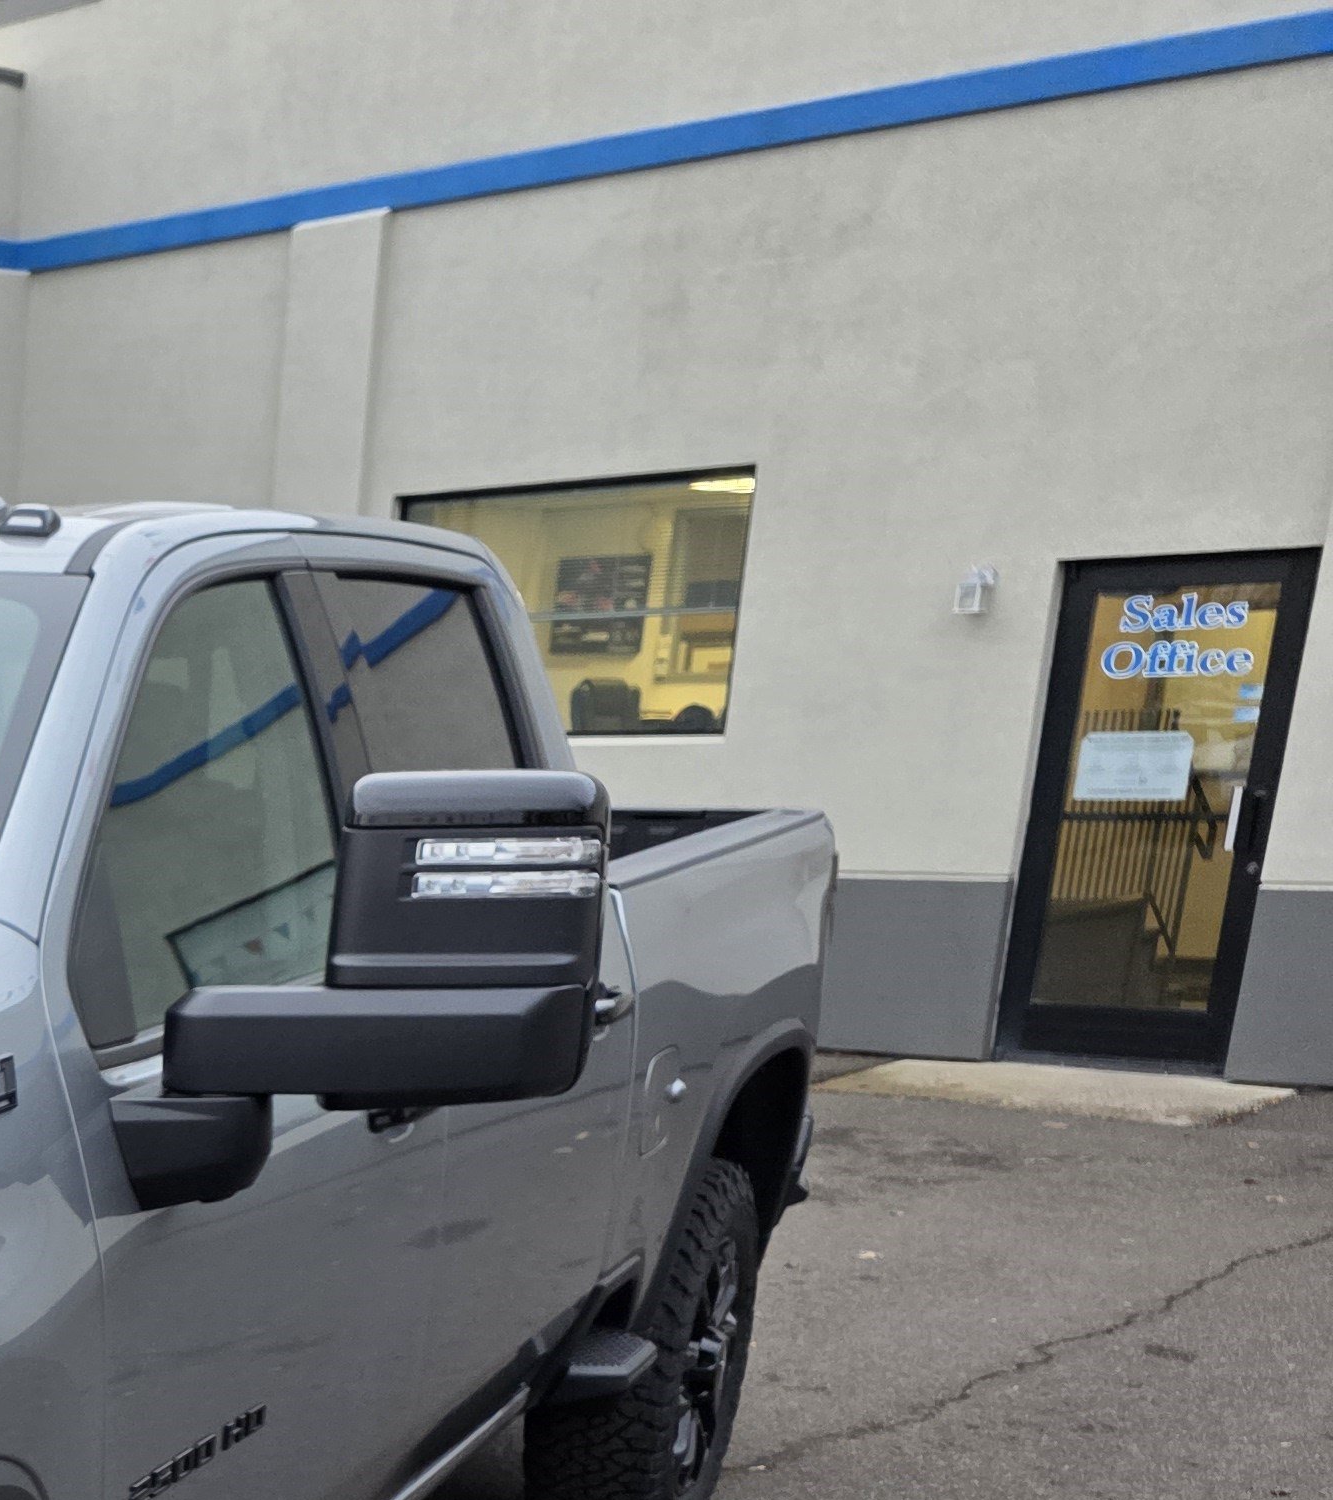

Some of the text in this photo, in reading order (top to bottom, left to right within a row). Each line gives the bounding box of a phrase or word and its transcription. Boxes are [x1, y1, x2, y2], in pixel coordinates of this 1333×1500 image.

[1120, 592, 1249, 633] Sales
[1101, 640, 1255, 680] Office
[221, 1401, 268, 1452] HD
